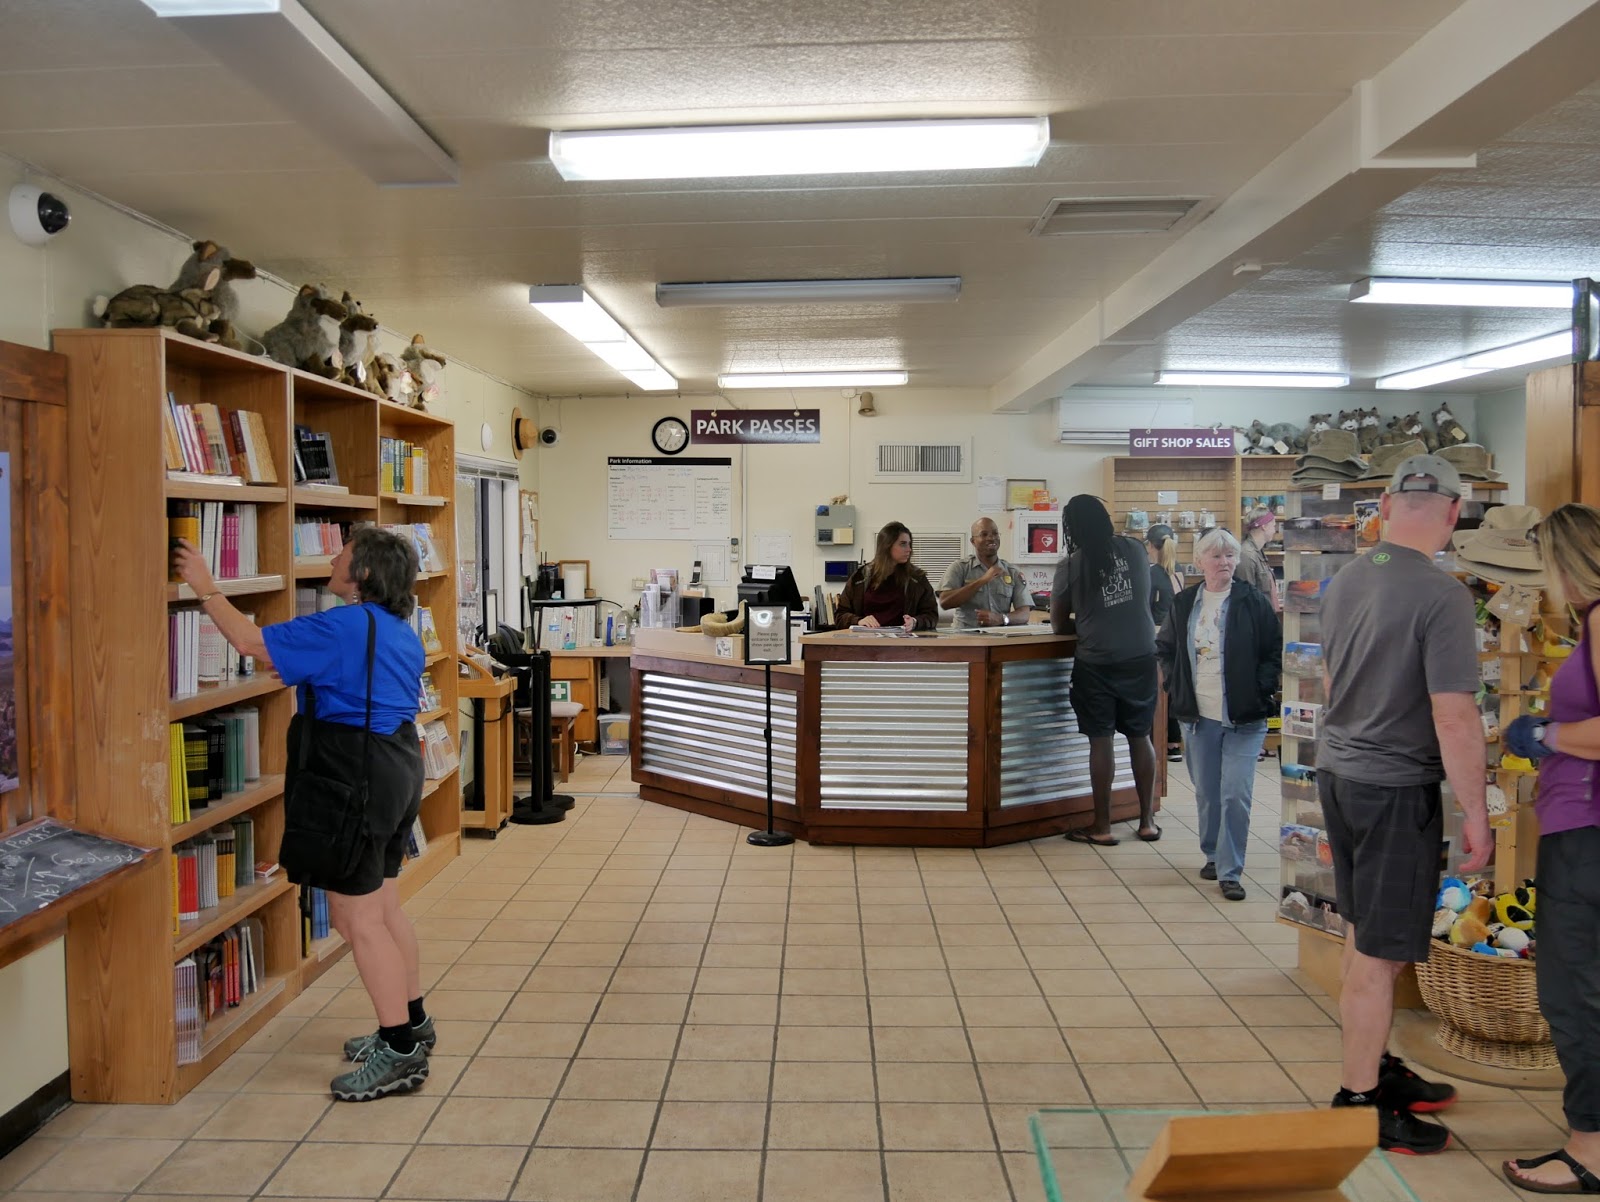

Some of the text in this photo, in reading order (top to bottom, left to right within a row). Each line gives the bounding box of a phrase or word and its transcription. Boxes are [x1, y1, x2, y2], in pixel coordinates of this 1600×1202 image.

[696, 418, 816, 435] PARK PASSES
[1133, 437, 1231, 448] GIFT SHOP SALES
[1033, 571, 1048, 579] NPA
[1101, 578, 1133, 597] LOCAL
[50, 850, 133, 867] Geology
